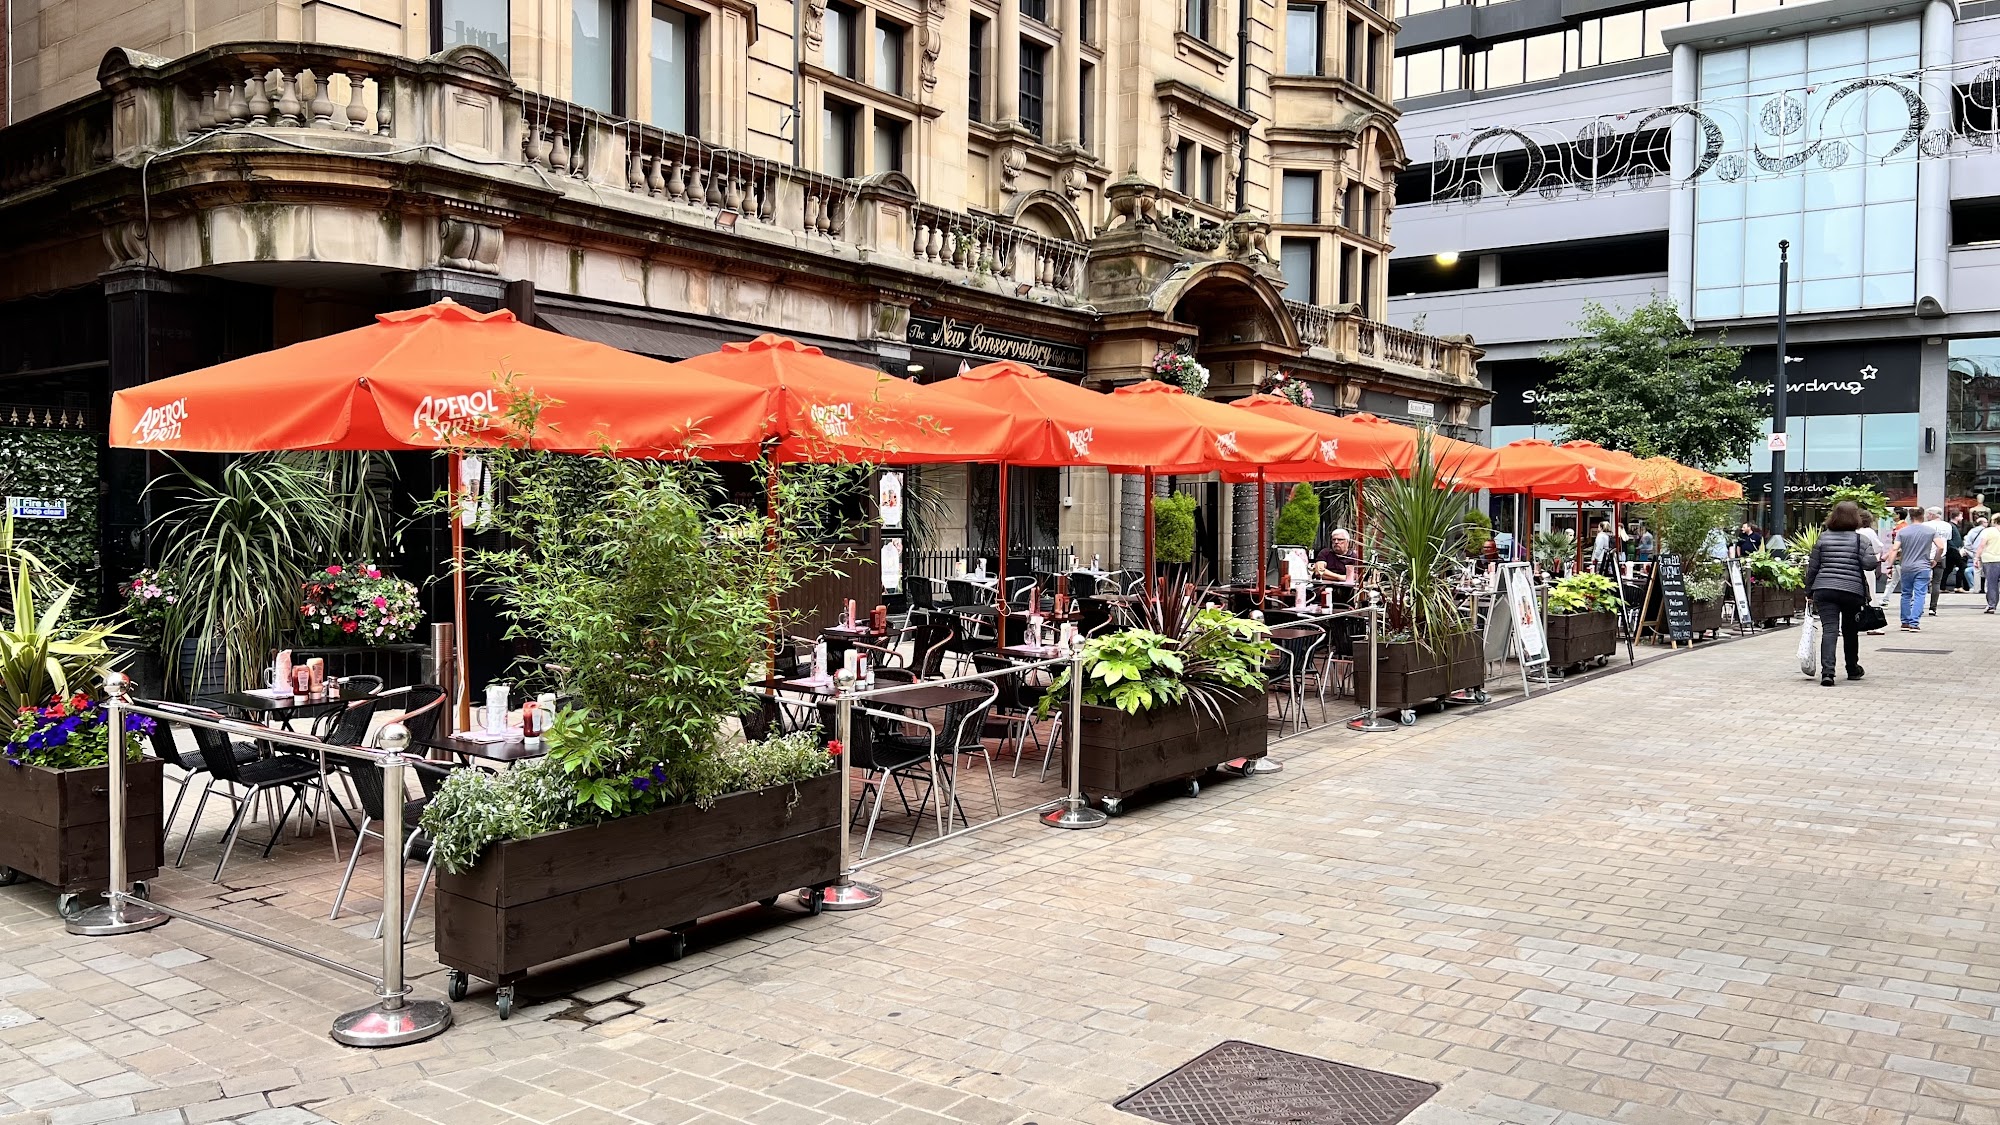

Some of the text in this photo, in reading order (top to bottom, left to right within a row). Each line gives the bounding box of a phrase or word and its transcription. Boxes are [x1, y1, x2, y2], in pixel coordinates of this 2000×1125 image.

[909, 324, 925, 340] The
[930, 315, 967, 348] New
[969, 323, 1053, 367] Conservatory
[131, 397, 189, 434] APEROL
[413, 389, 499, 429] APEROL
[23, 499, 42, 507] Fire
[23, 508, 42, 516] Keep
